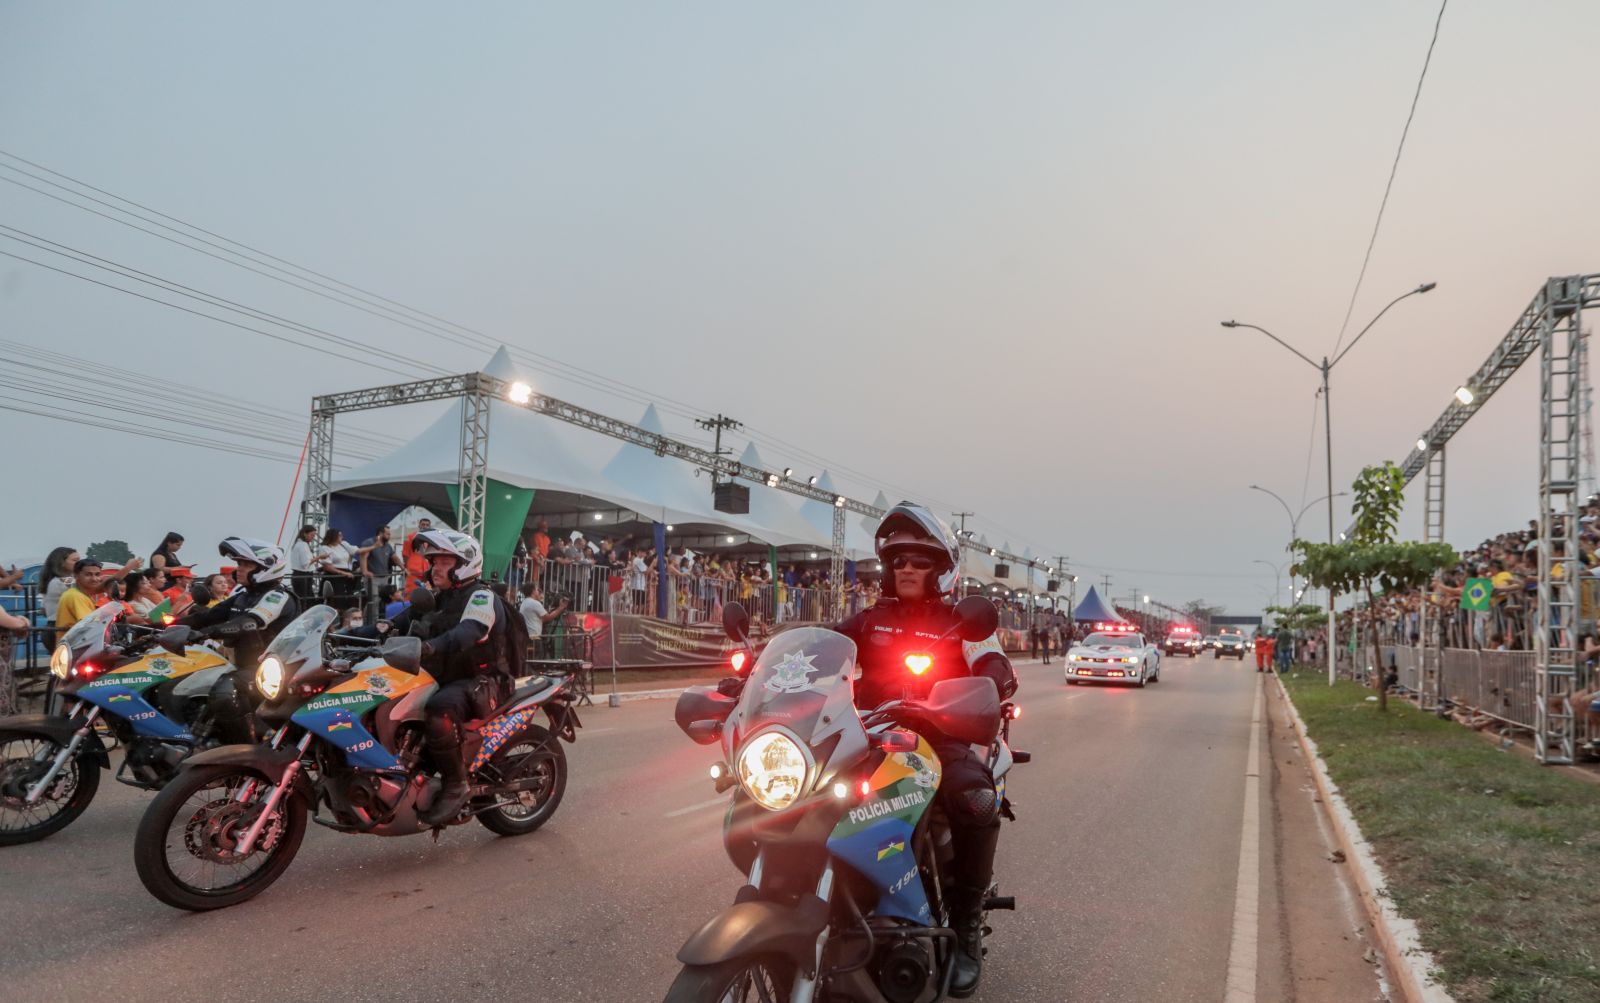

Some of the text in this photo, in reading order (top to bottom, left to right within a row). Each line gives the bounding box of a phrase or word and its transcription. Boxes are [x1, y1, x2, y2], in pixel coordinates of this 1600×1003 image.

[90, 676, 152, 688] POLÍCIA MILITAR
[307, 694, 374, 711] POLÍCIA MILITAR
[135, 711, 156, 721] 190
[352, 740, 374, 752] 190
[848, 791, 925, 824] POLÍCIA MILITAR
[896, 864, 918, 891] 190
